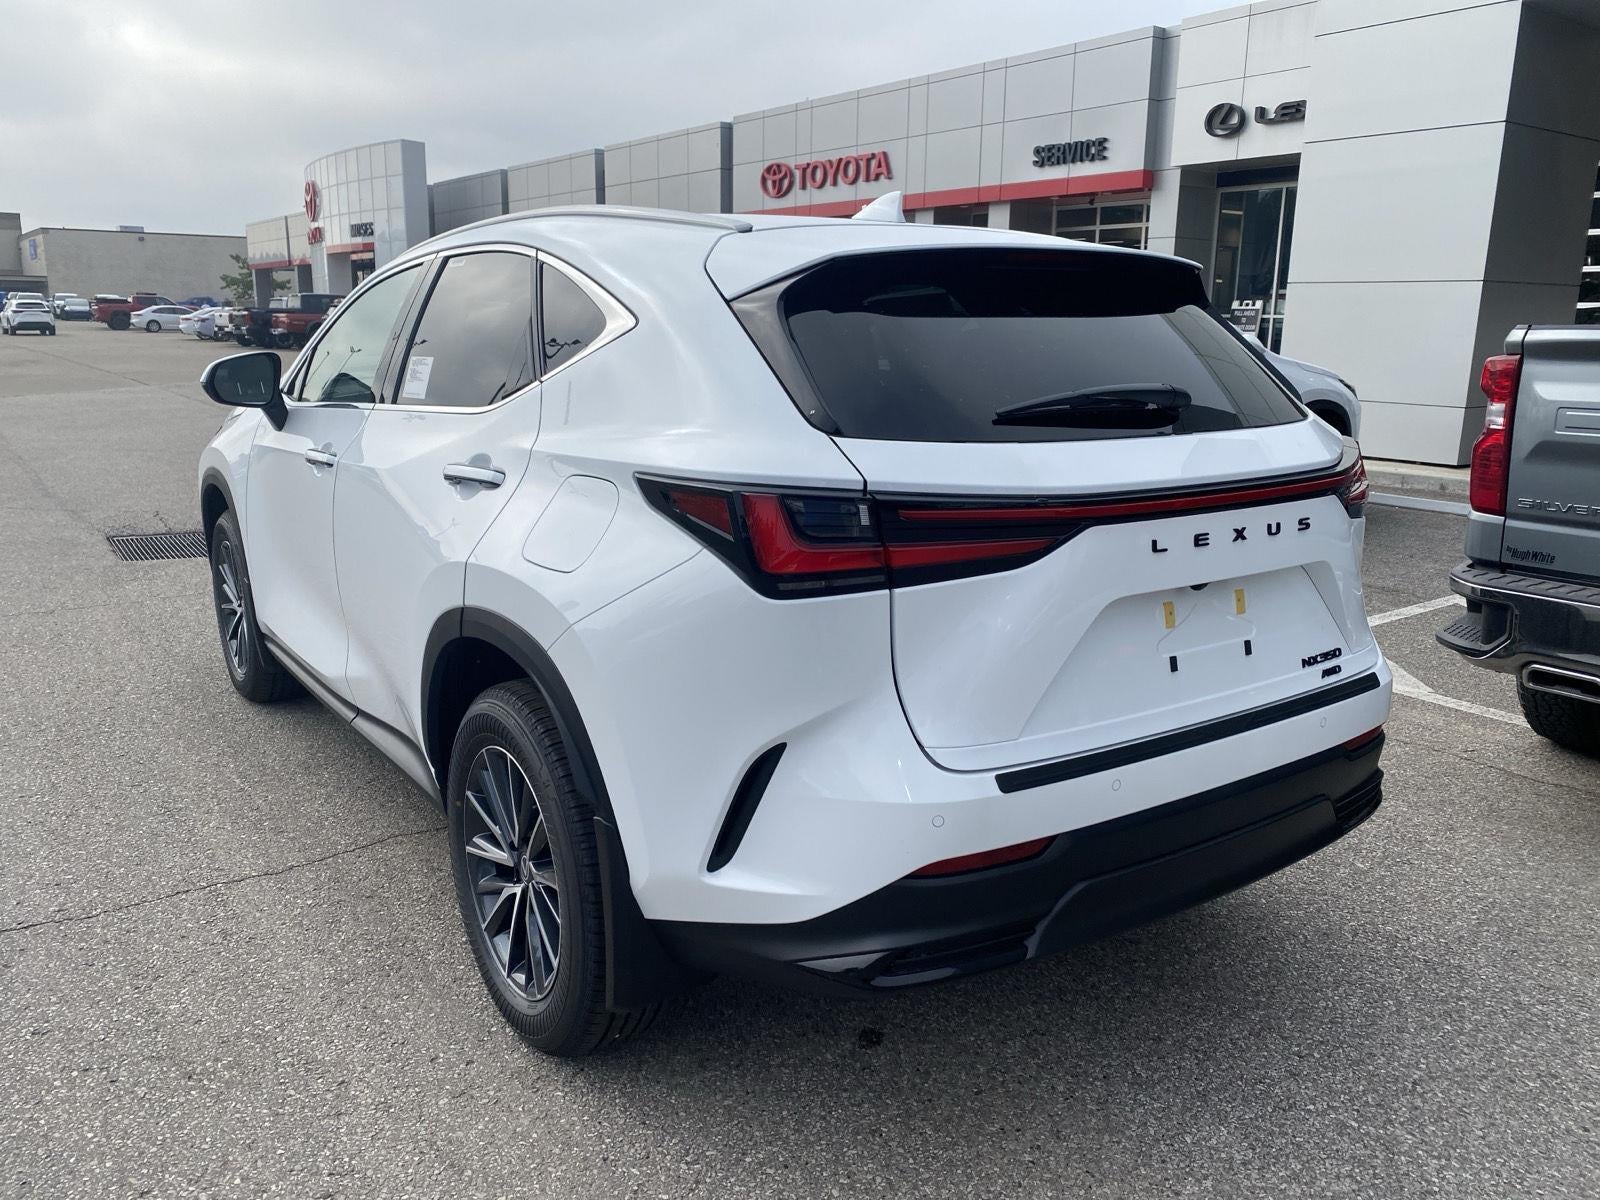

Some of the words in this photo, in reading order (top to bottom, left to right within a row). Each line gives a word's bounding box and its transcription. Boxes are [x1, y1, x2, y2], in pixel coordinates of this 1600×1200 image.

[1032, 137, 1111, 168] SERVICE
[795, 150, 893, 191] TOYOTA
[1151, 516, 1311, 554] LEXUS
[1301, 647, 1342, 669] NX350
